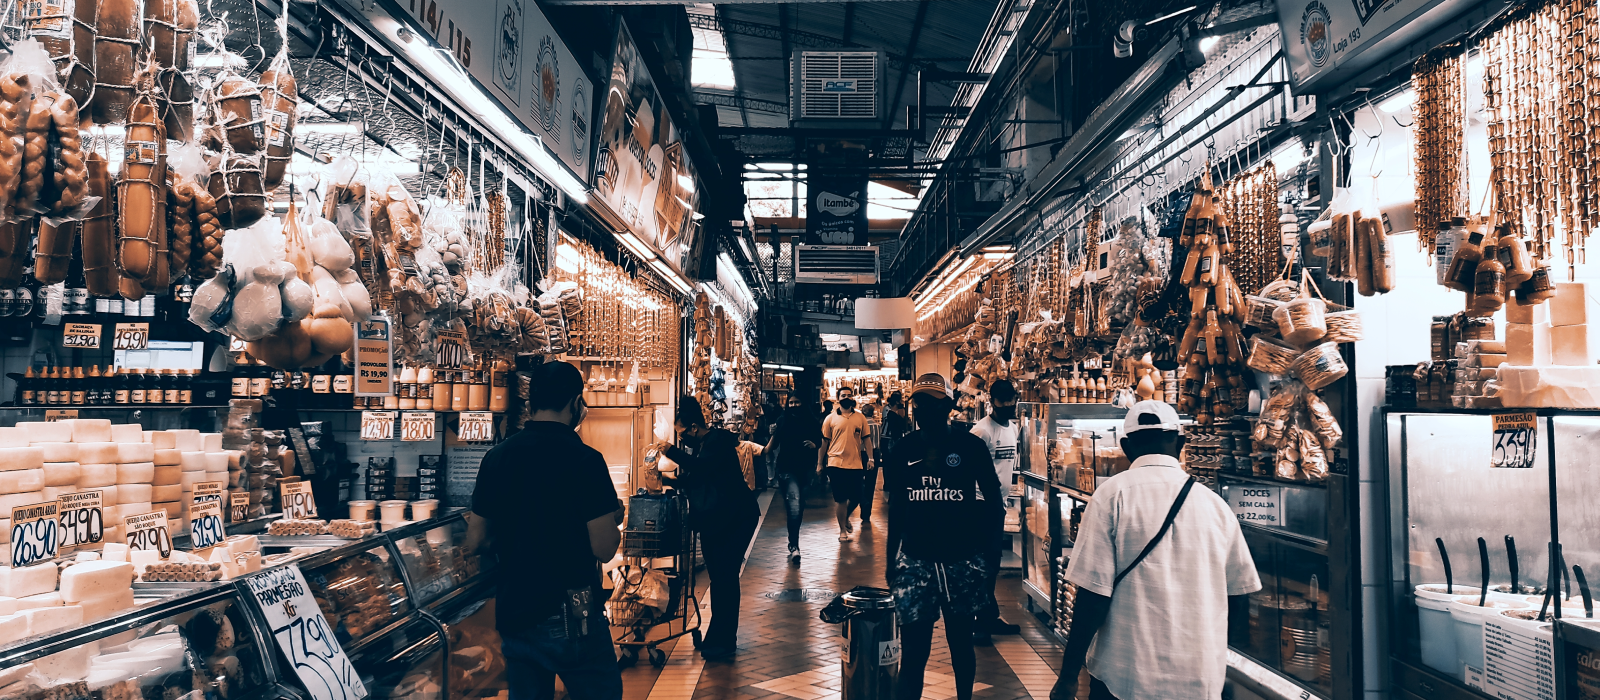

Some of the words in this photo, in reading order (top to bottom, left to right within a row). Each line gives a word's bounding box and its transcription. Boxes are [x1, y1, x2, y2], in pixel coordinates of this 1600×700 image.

[1333, 38, 1348, 53] Loja
[1348, 27, 1361, 43] 193
[360, 369, 370, 378] R$
[370, 370, 388, 379] 19,90
[1495, 414, 1533, 423] PARMESÃO
[922, 476, 941, 488] Fly
[73, 492, 100, 501] CANASTRA
[1243, 489, 1270, 497] DOCES
[67, 501, 82, 509] ROQUE
[140, 512, 164, 522] CANASTRA
[143, 520, 157, 529] ROQUE
[256, 581, 304, 607] PARMESÃO
